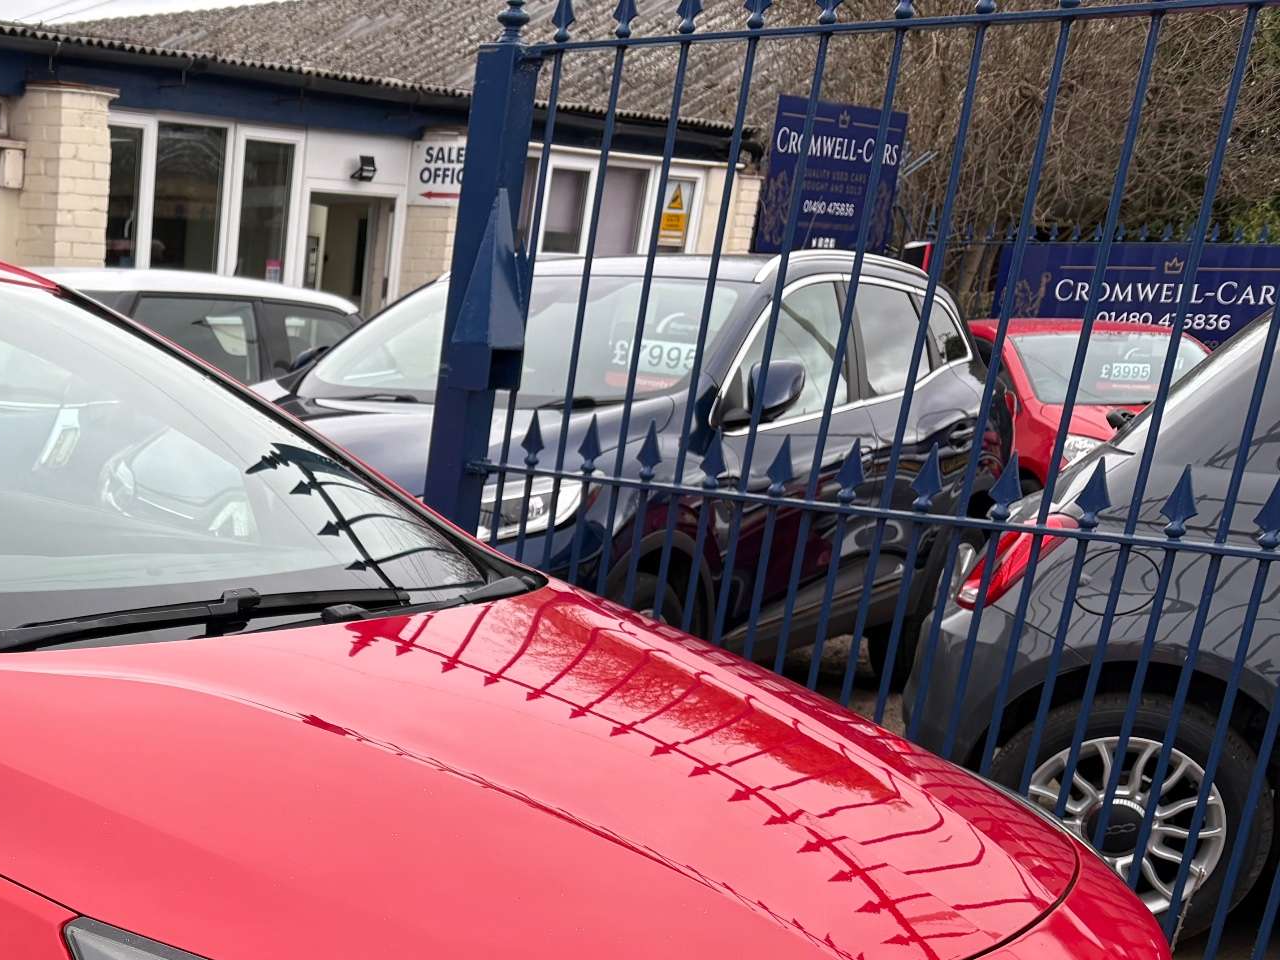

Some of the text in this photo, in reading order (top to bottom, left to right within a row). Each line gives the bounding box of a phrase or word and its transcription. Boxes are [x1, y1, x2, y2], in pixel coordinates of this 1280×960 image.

[424, 146, 465, 164] SALE
[776, 126, 899, 166] CRMWELL-CRS
[420, 167, 464, 184] OFFIC
[1055, 278, 1276, 305] CROMWELL-CAR
[1157, 313, 1232, 331] 45836
[612, 340, 696, 370] £995
